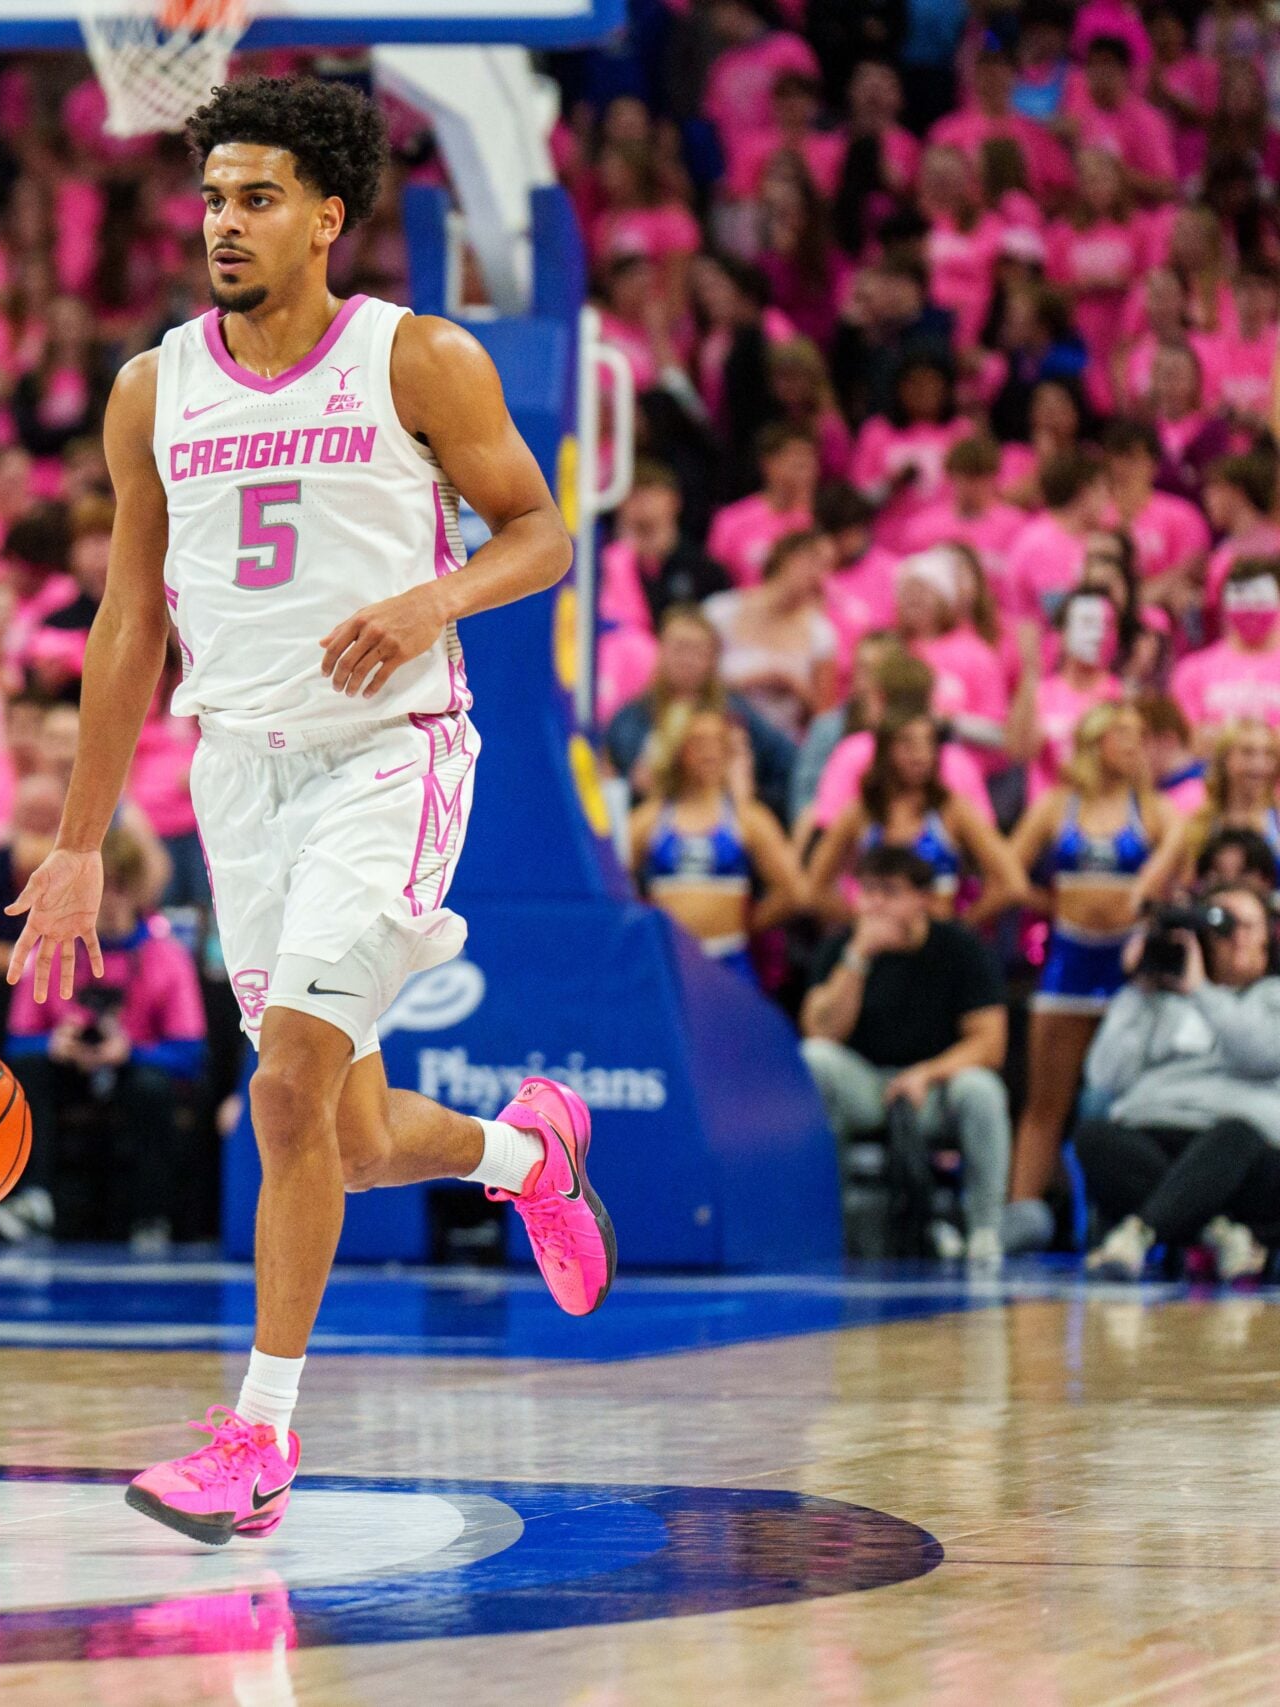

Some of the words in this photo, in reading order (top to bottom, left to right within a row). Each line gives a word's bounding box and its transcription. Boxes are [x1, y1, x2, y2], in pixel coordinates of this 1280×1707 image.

[325, 401, 363, 411] EAST
[328, 393, 356, 403] BIG
[170, 426, 377, 481] CREIGHTON
[232, 479, 302, 590] 5
